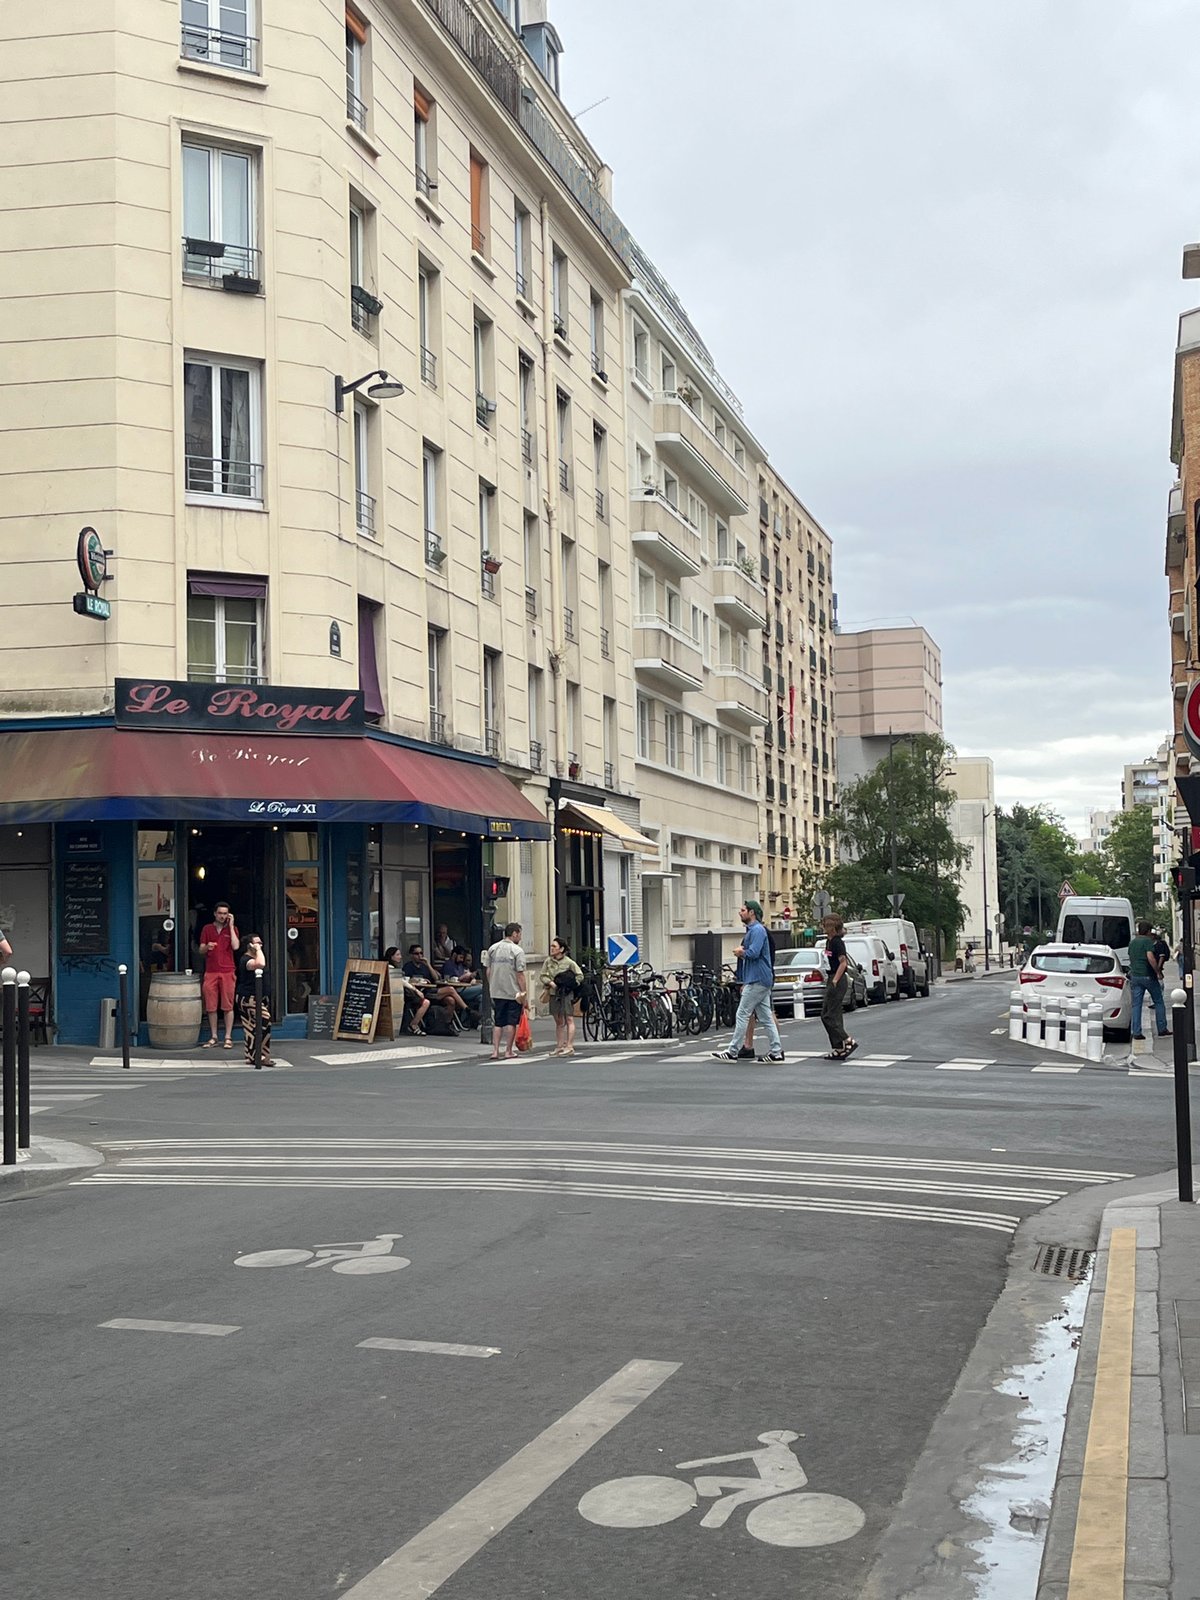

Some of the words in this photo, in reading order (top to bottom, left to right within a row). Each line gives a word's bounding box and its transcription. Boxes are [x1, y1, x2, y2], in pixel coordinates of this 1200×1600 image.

[125, 684, 190, 714] Le
[207, 689, 357, 730] Royal
[248, 801, 266, 813] Le
[267, 801, 302, 818] Royal
[302, 803, 317, 814] XI
